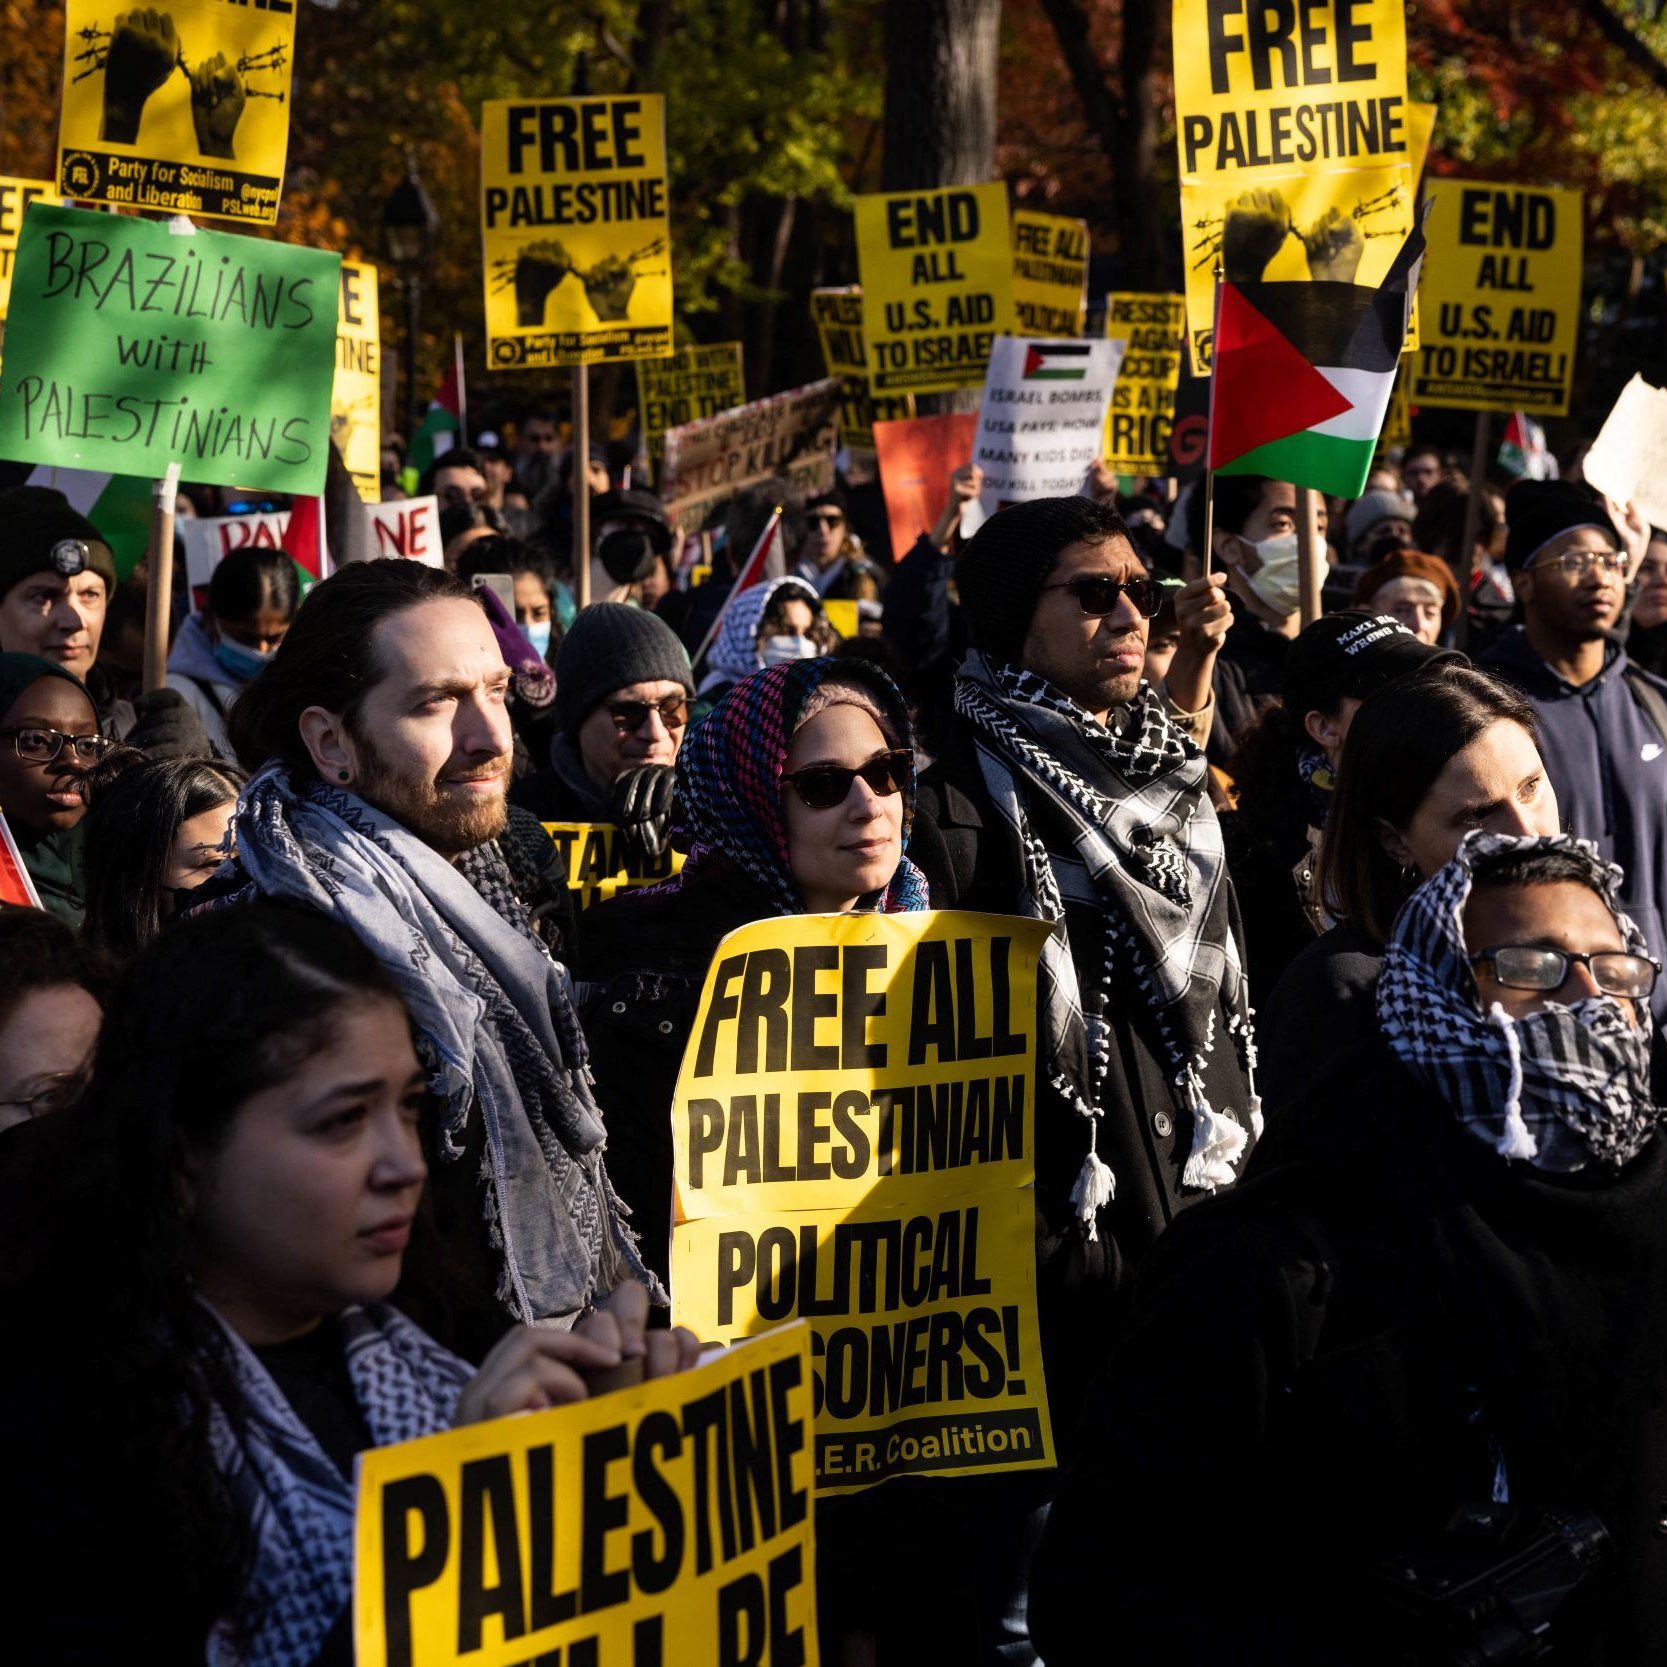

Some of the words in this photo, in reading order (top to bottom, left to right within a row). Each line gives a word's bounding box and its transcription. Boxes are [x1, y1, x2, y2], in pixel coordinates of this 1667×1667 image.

[1205, 0, 1377, 94] FREE
[508, 101, 645, 174] FREE
[1183, 97, 1407, 173] PALESTINE
[108, 156, 148, 183] Party
[151, 161, 176, 184] for
[105, 182, 134, 202] and
[486, 179, 665, 229] PALESTINE
[886, 192, 981, 251] END
[1459, 188, 1557, 251] END
[912, 250, 967, 286] ALL
[1475, 254, 1535, 293] ALL
[884, 299, 940, 334] U.S.
[946, 292, 996, 328] AID
[1111, 300, 1182, 325] RESIST
[1438, 302, 1499, 341] U.S.
[1506, 308, 1557, 345] AID
[872, 339, 908, 370] TO
[1421, 343, 1457, 378] TO
[1463, 347, 1567, 385] ISRAEL!
[989, 388, 1043, 405] ISRAEL
[1335, 620, 1377, 646] MAKE
[693, 943, 888, 1079] FREE
[907, 936, 1027, 1067] ALL
[687, 1073, 1026, 1191] PALESTINIAN
[717, 1206, 991, 1326] POLITICAL
[886, 1424, 1031, 1466] Coalition
[381, 1353, 808, 1667] PALESTINE
